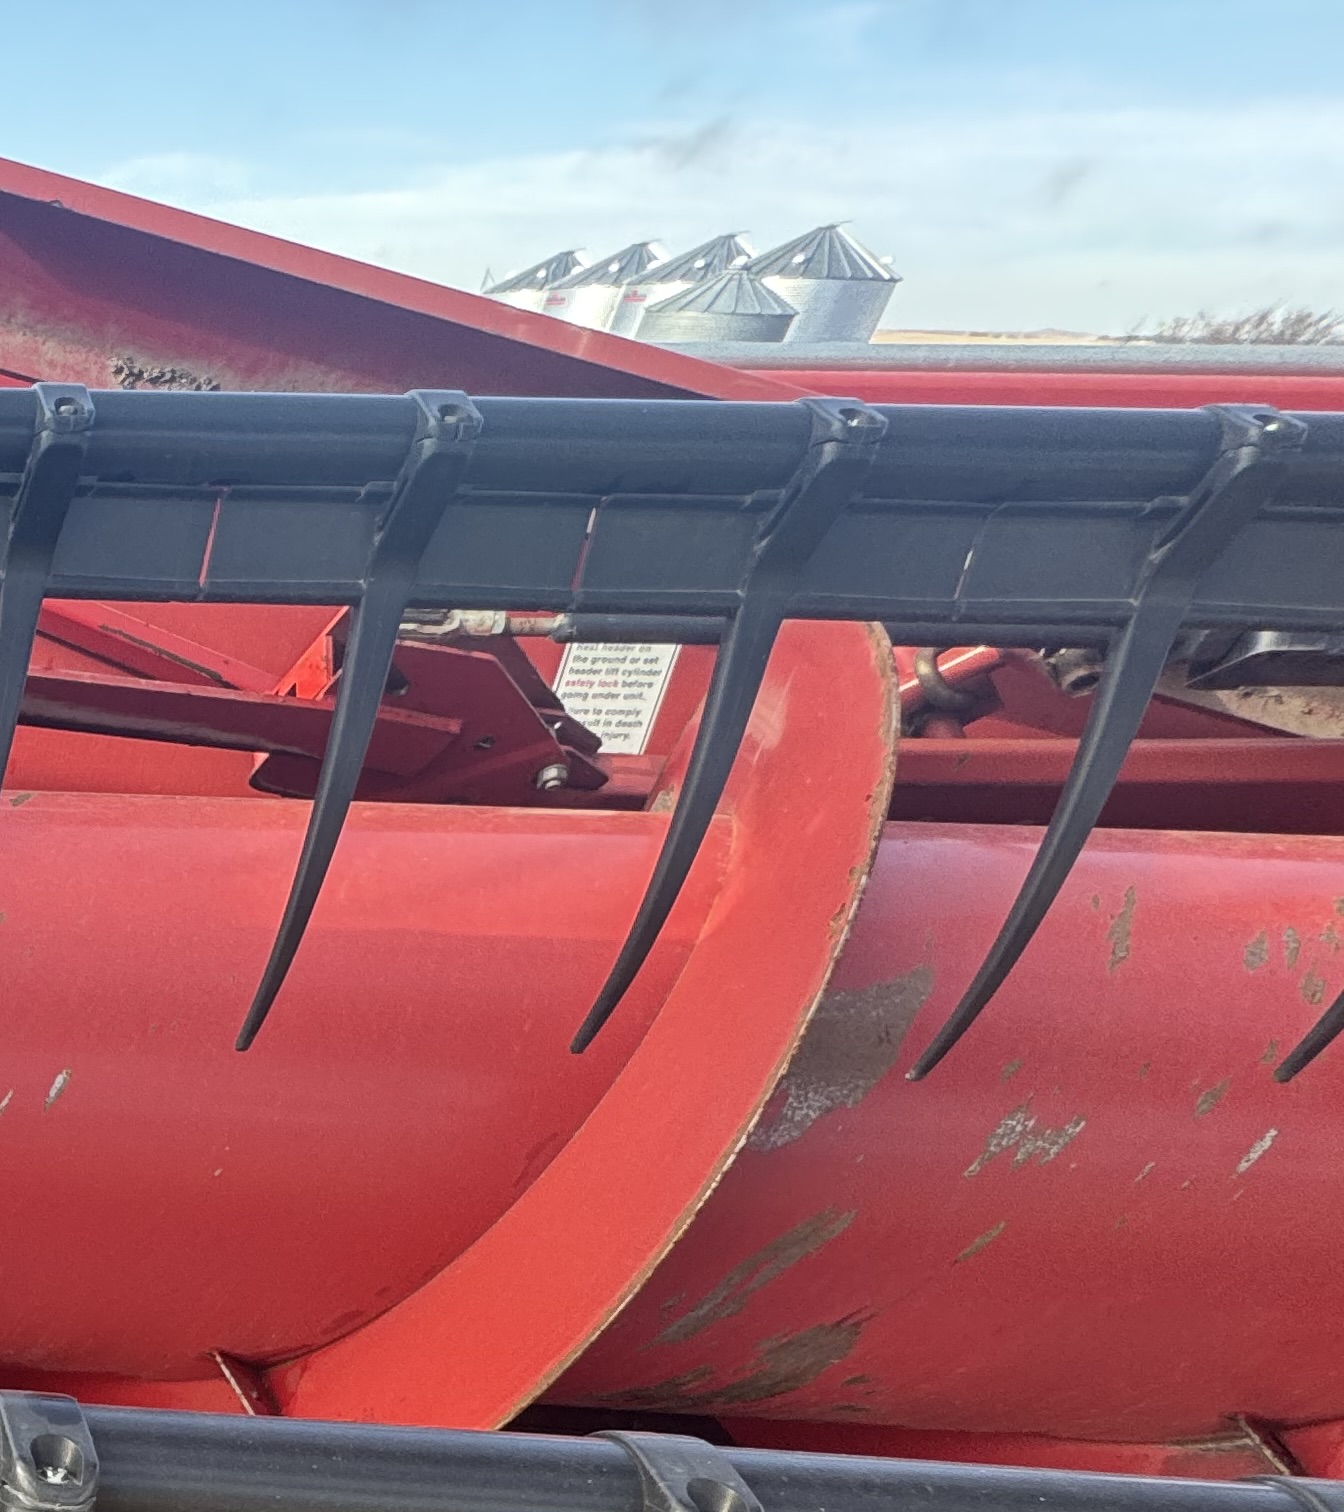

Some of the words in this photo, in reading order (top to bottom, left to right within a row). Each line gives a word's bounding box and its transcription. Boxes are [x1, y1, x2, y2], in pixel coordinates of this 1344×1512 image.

[572, 654, 589, 663] the
[590, 655, 628, 665] ground
[629, 657, 641, 665] or
[643, 656, 659, 665] set
[568, 666, 603, 676] header
[604, 667, 619, 676] lift
[621, 667, 662, 678] cylinder
[565, 678, 595, 689] safety
[598, 679, 619, 688] lock
[621, 679, 654, 688] before
[560, 691, 589, 701] going
[591, 692, 621, 700] under
[592, 707, 603, 716] to
[605, 708, 642, 718] comply
[602, 719, 612, 727] in
[614, 719, 643, 728] death
